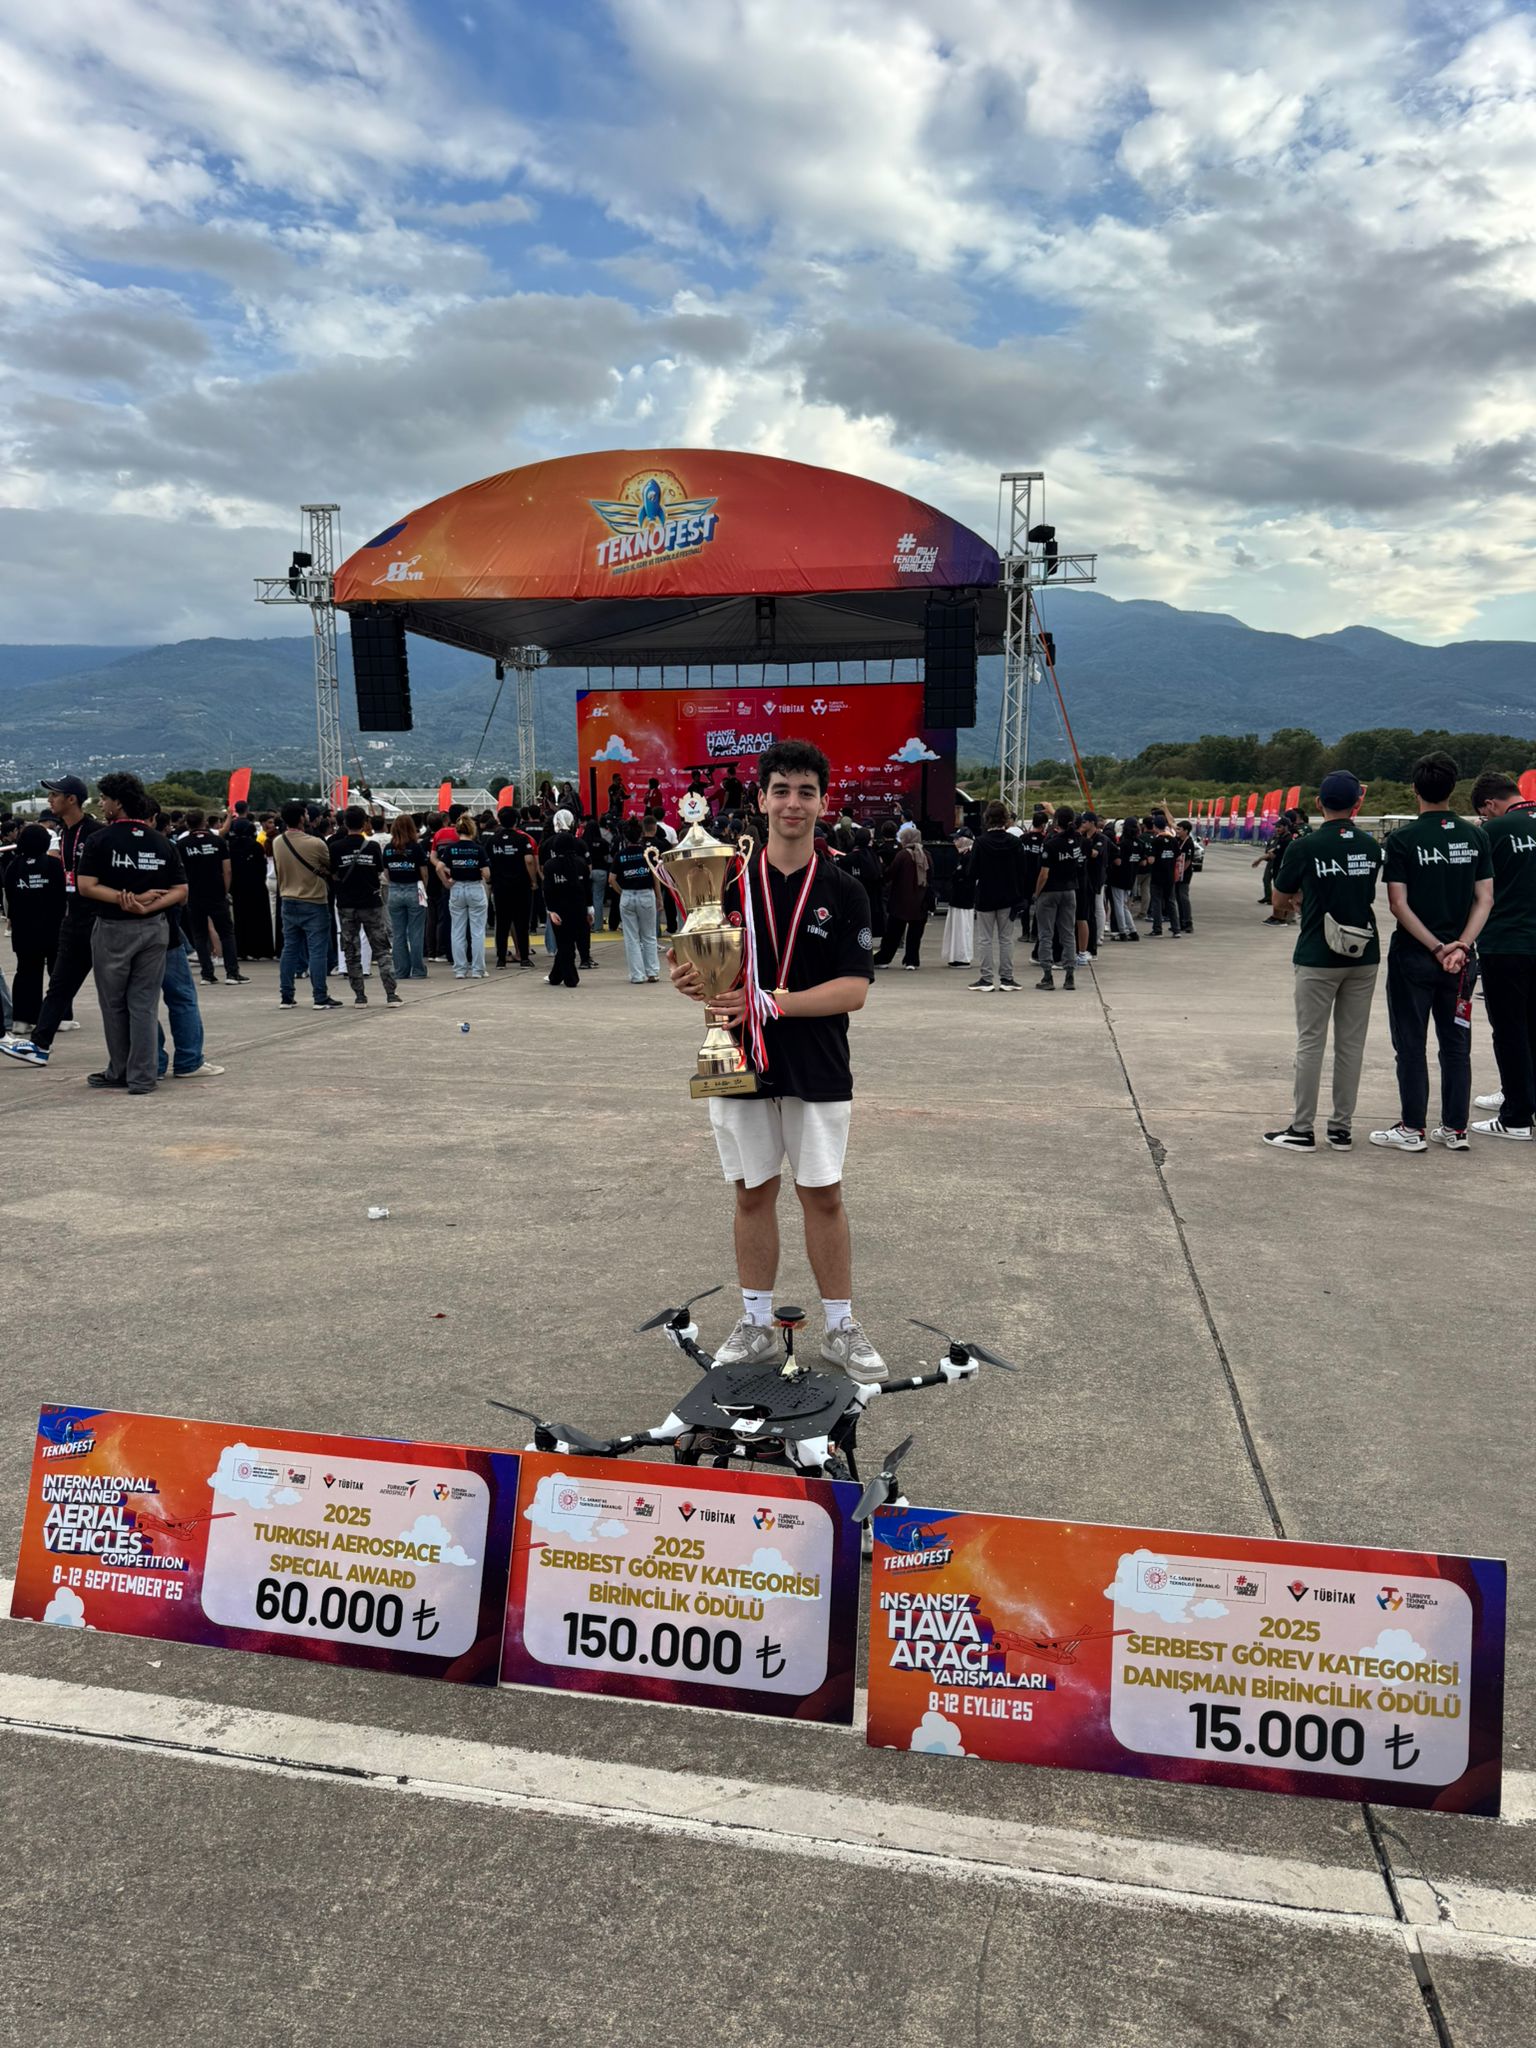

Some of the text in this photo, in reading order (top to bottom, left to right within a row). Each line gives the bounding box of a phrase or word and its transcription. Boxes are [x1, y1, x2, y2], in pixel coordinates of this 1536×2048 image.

[597, 513, 719, 567] TEKNOFEST
[779, 704, 805, 714] TÜBİTAK
[706, 732, 773, 747] HAVA ARACI
[42, 1439, 95, 1458] TEKNOFEST
[42, 1488, 121, 1504] UNMANNED
[43, 1474, 153, 1492] INTERNATIONAL
[338, 1478, 364, 1490] TÜBİTAK
[44, 1503, 130, 1532] AERIAL
[323, 1503, 371, 1527] 2025
[700, 1508, 736, 1525] TÜBİTAK
[43, 1527, 143, 1555] VEHICLES
[254, 1522, 441, 1563] TURKISH AEROSPACE
[653, 1535, 705, 1560] 2025
[101, 1553, 184, 1570] COMPETITION
[269, 1553, 416, 1590] SPECIAL AWARD
[540, 1548, 821, 1597] SERBEST GÖREV KATEGORİSİ
[883, 1548, 953, 1571] TEKNOFEST
[52, 1565, 185, 1601] 8-12 SEPTEMBER'25
[1313, 1587, 1356, 1604] TÜBİTAK
[256, 1577, 403, 1638] 60.000
[589, 1580, 765, 1622] BİRİNCİLİK ÖDÜLÜ
[880, 1591, 970, 1613] İNSANSIZ
[888, 1609, 981, 1643] HAVA
[1259, 1616, 1321, 1642] 2025
[563, 1612, 742, 1675] 150.000
[889, 1640, 989, 1671] ARACI
[1126, 1634, 1459, 1686] SERBEST GÖREV KATEGORİSİ
[930, 1668, 1047, 1689] YARIŞMALARI
[929, 1691, 959, 1714] 8-12
[1123, 1665, 1462, 1719] DANIŞMAN BİRİNCİLİK ÖDÜLÜ
[1189, 1702, 1365, 1766] 15.000
